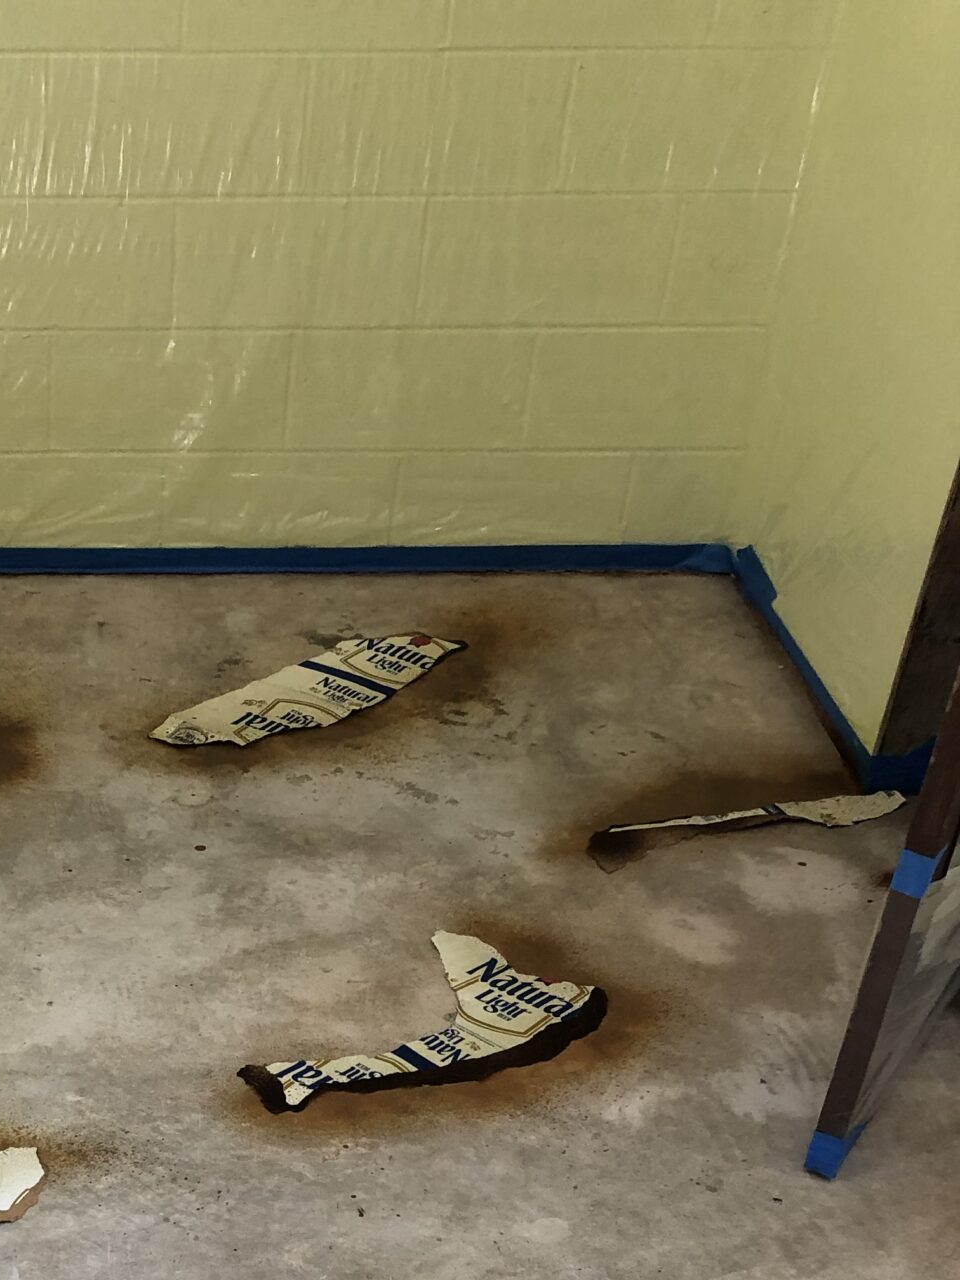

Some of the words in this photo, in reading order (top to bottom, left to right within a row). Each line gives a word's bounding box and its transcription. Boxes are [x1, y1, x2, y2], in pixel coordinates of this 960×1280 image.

[366, 653, 408, 673] Light
[316, 676, 378, 703] Natural
[474, 989, 529, 1018] Light
